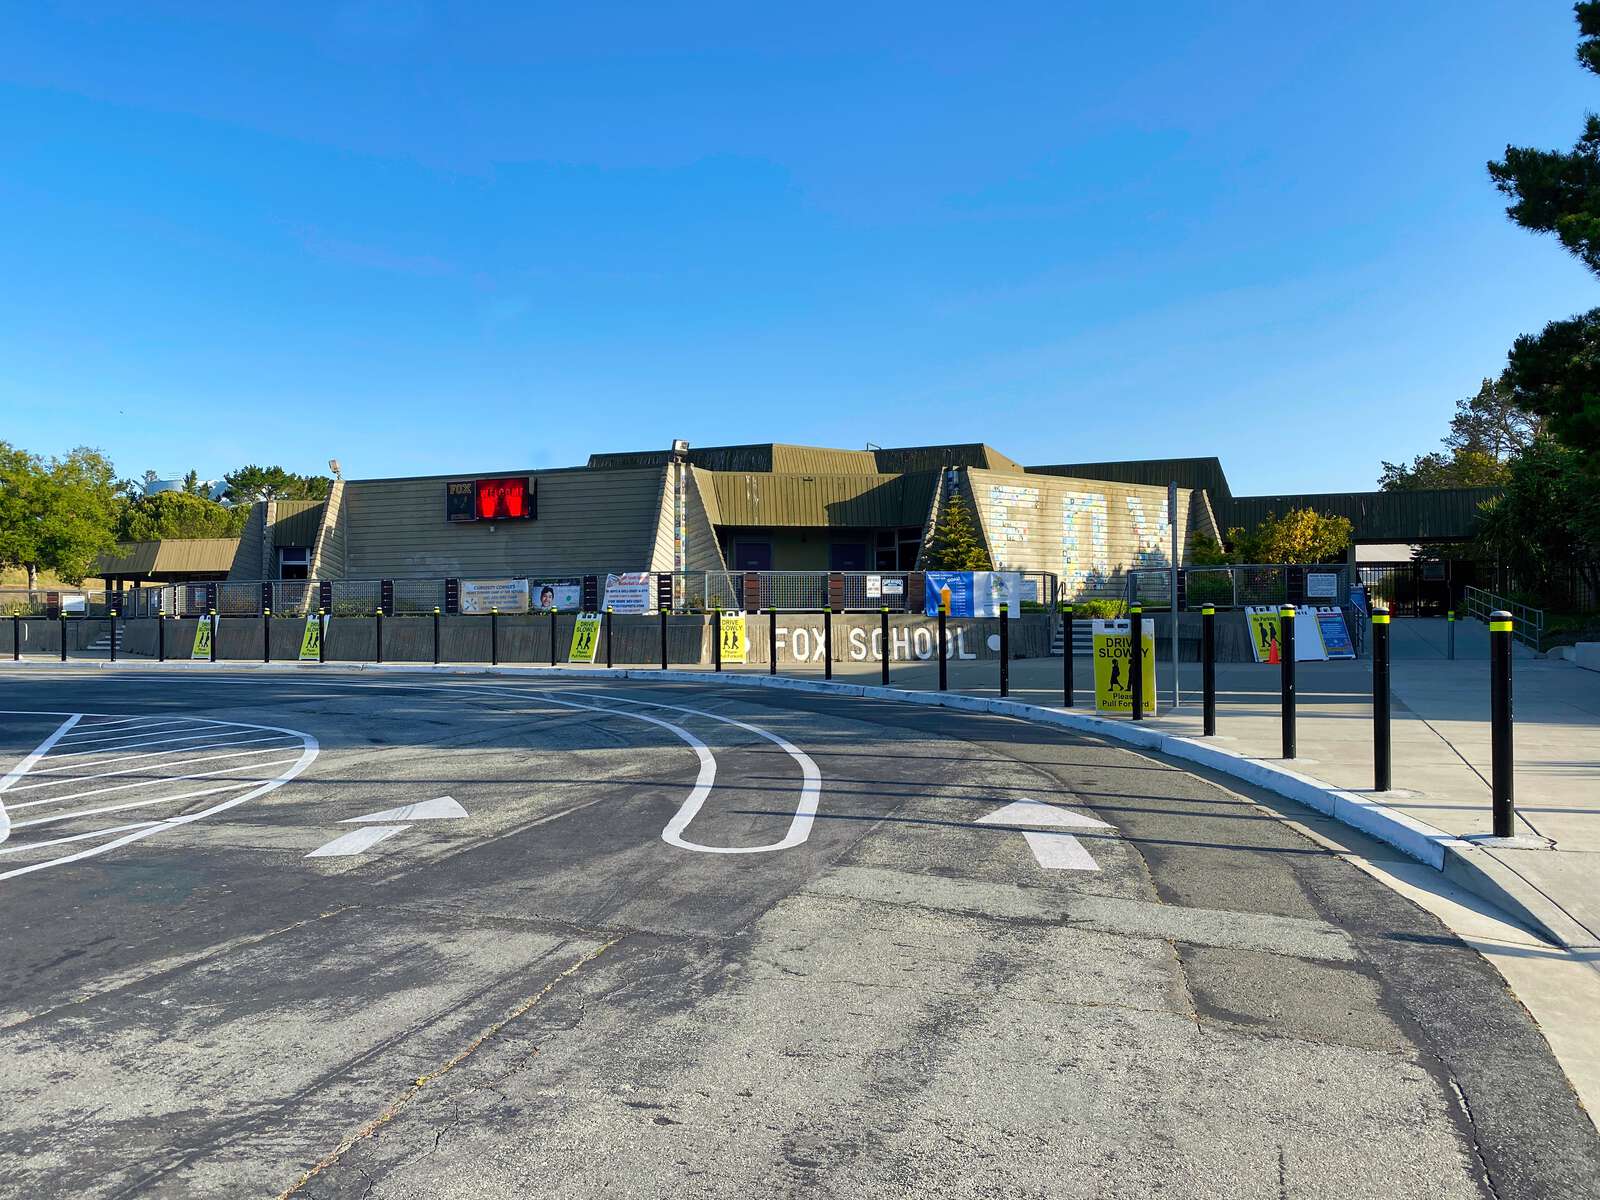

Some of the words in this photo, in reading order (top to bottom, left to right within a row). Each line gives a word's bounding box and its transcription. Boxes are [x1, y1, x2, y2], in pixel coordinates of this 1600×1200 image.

[449, 484, 472, 494] FOX
[775, 627, 827, 661] FOX
[849, 626, 977, 661] SCHOOL
[1106, 637, 1135, 648] DRIV
[1098, 647, 1149, 658] SLOWY
[1113, 692, 1133, 700] Pleas
